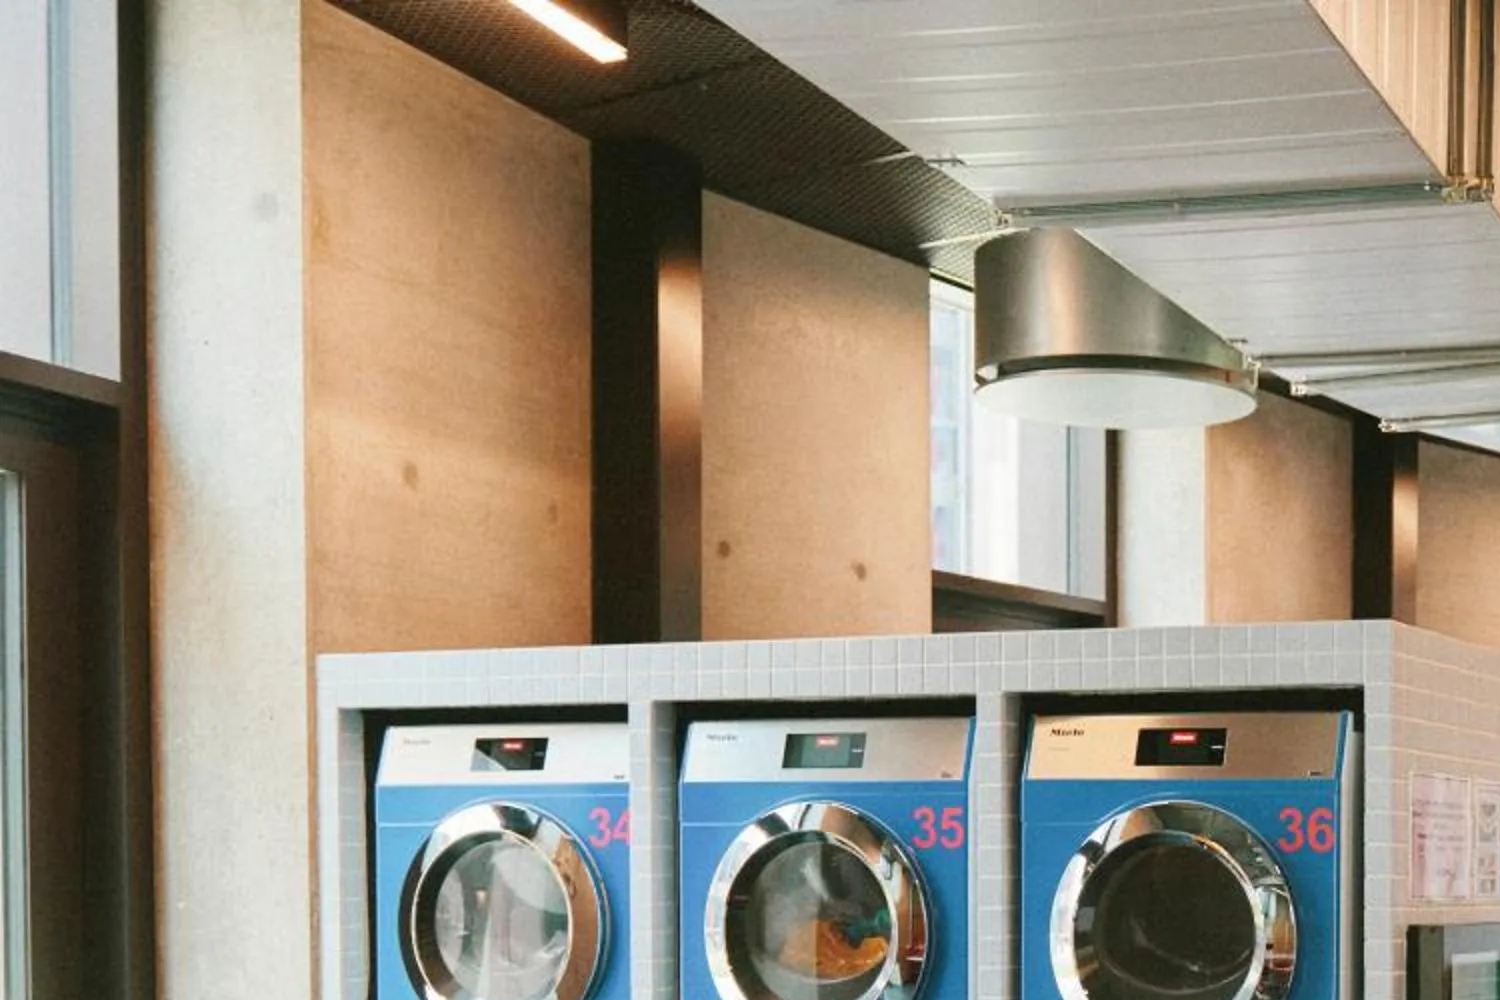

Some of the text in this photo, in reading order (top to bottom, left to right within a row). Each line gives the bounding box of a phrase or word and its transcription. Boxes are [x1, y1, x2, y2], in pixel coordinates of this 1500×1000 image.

[587, 807, 631, 848] 34
[912, 807, 964, 849] 35
[1278, 805, 1334, 854] 36
